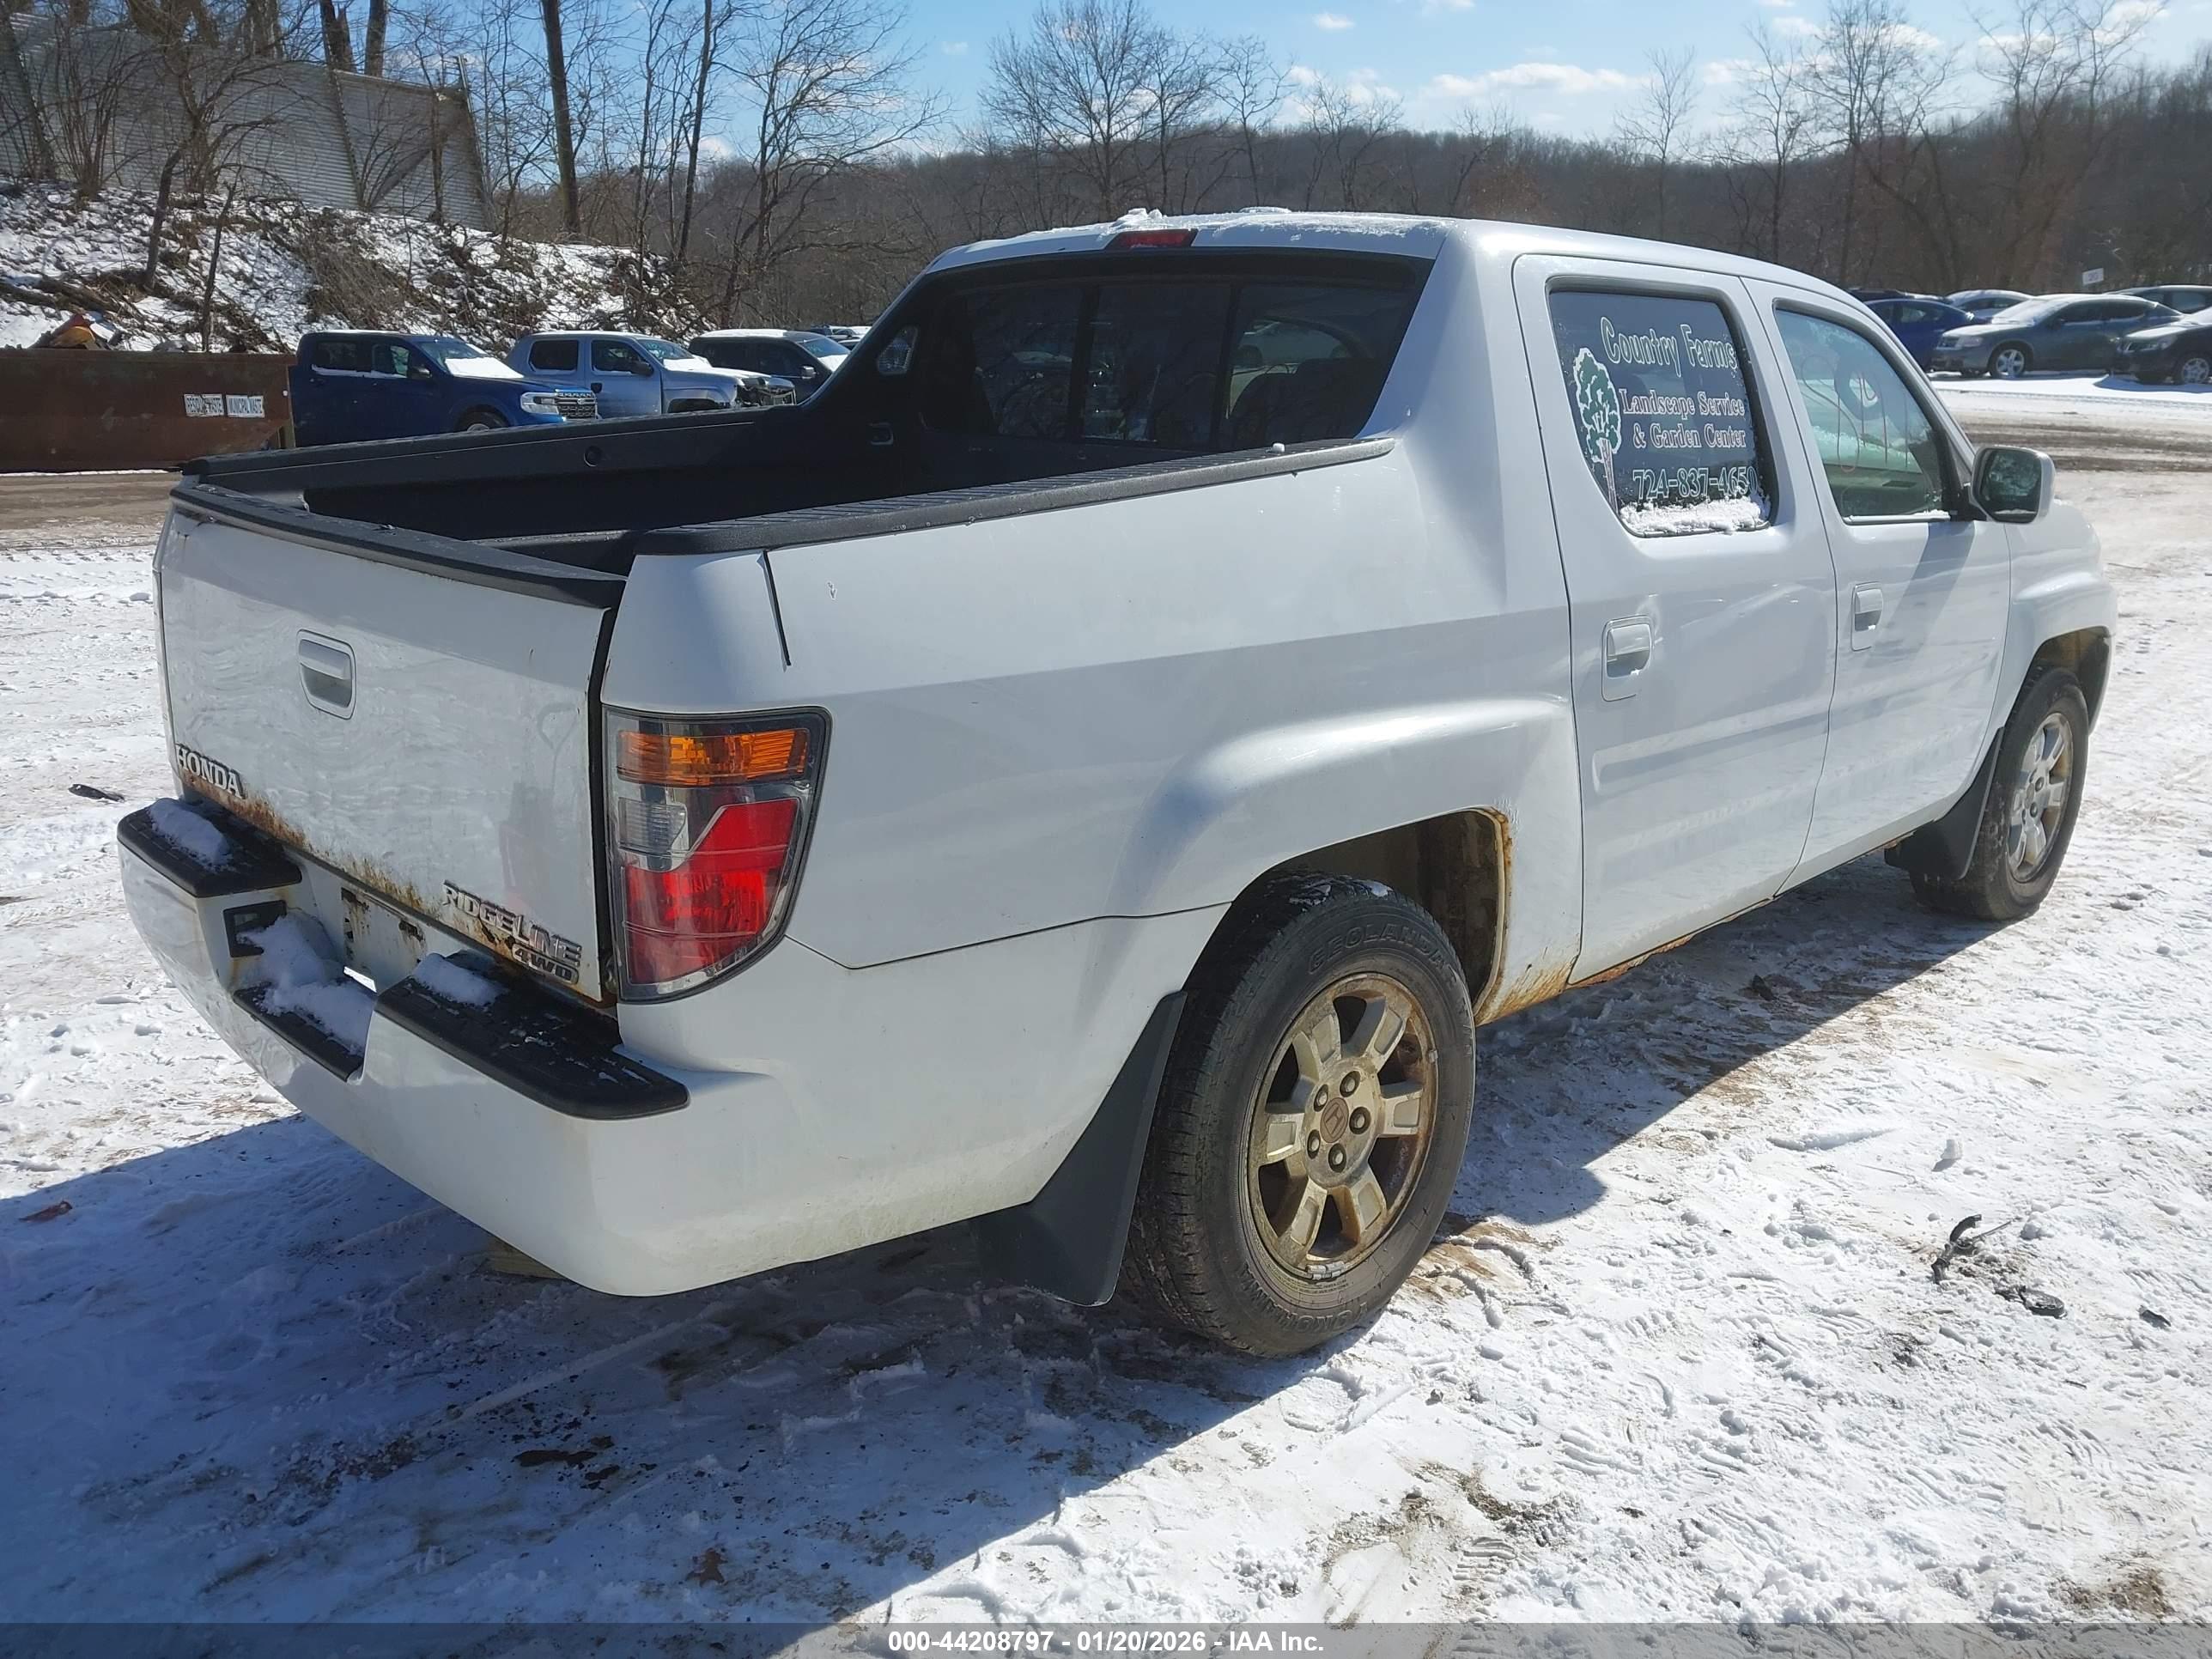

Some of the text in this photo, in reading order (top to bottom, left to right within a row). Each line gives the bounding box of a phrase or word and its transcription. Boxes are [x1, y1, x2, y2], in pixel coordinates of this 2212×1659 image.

[1600, 316, 1738, 377] Country Farms
[1619, 388, 1746, 420] Landscape Service
[1632, 422, 1747, 449] & Garden Center
[1632, 466, 1758, 500] 724-837-4650
[175, 744, 244, 799] HONDA
[442, 880, 582, 968] RIDGELINE
[513, 945, 578, 984] 4WD
